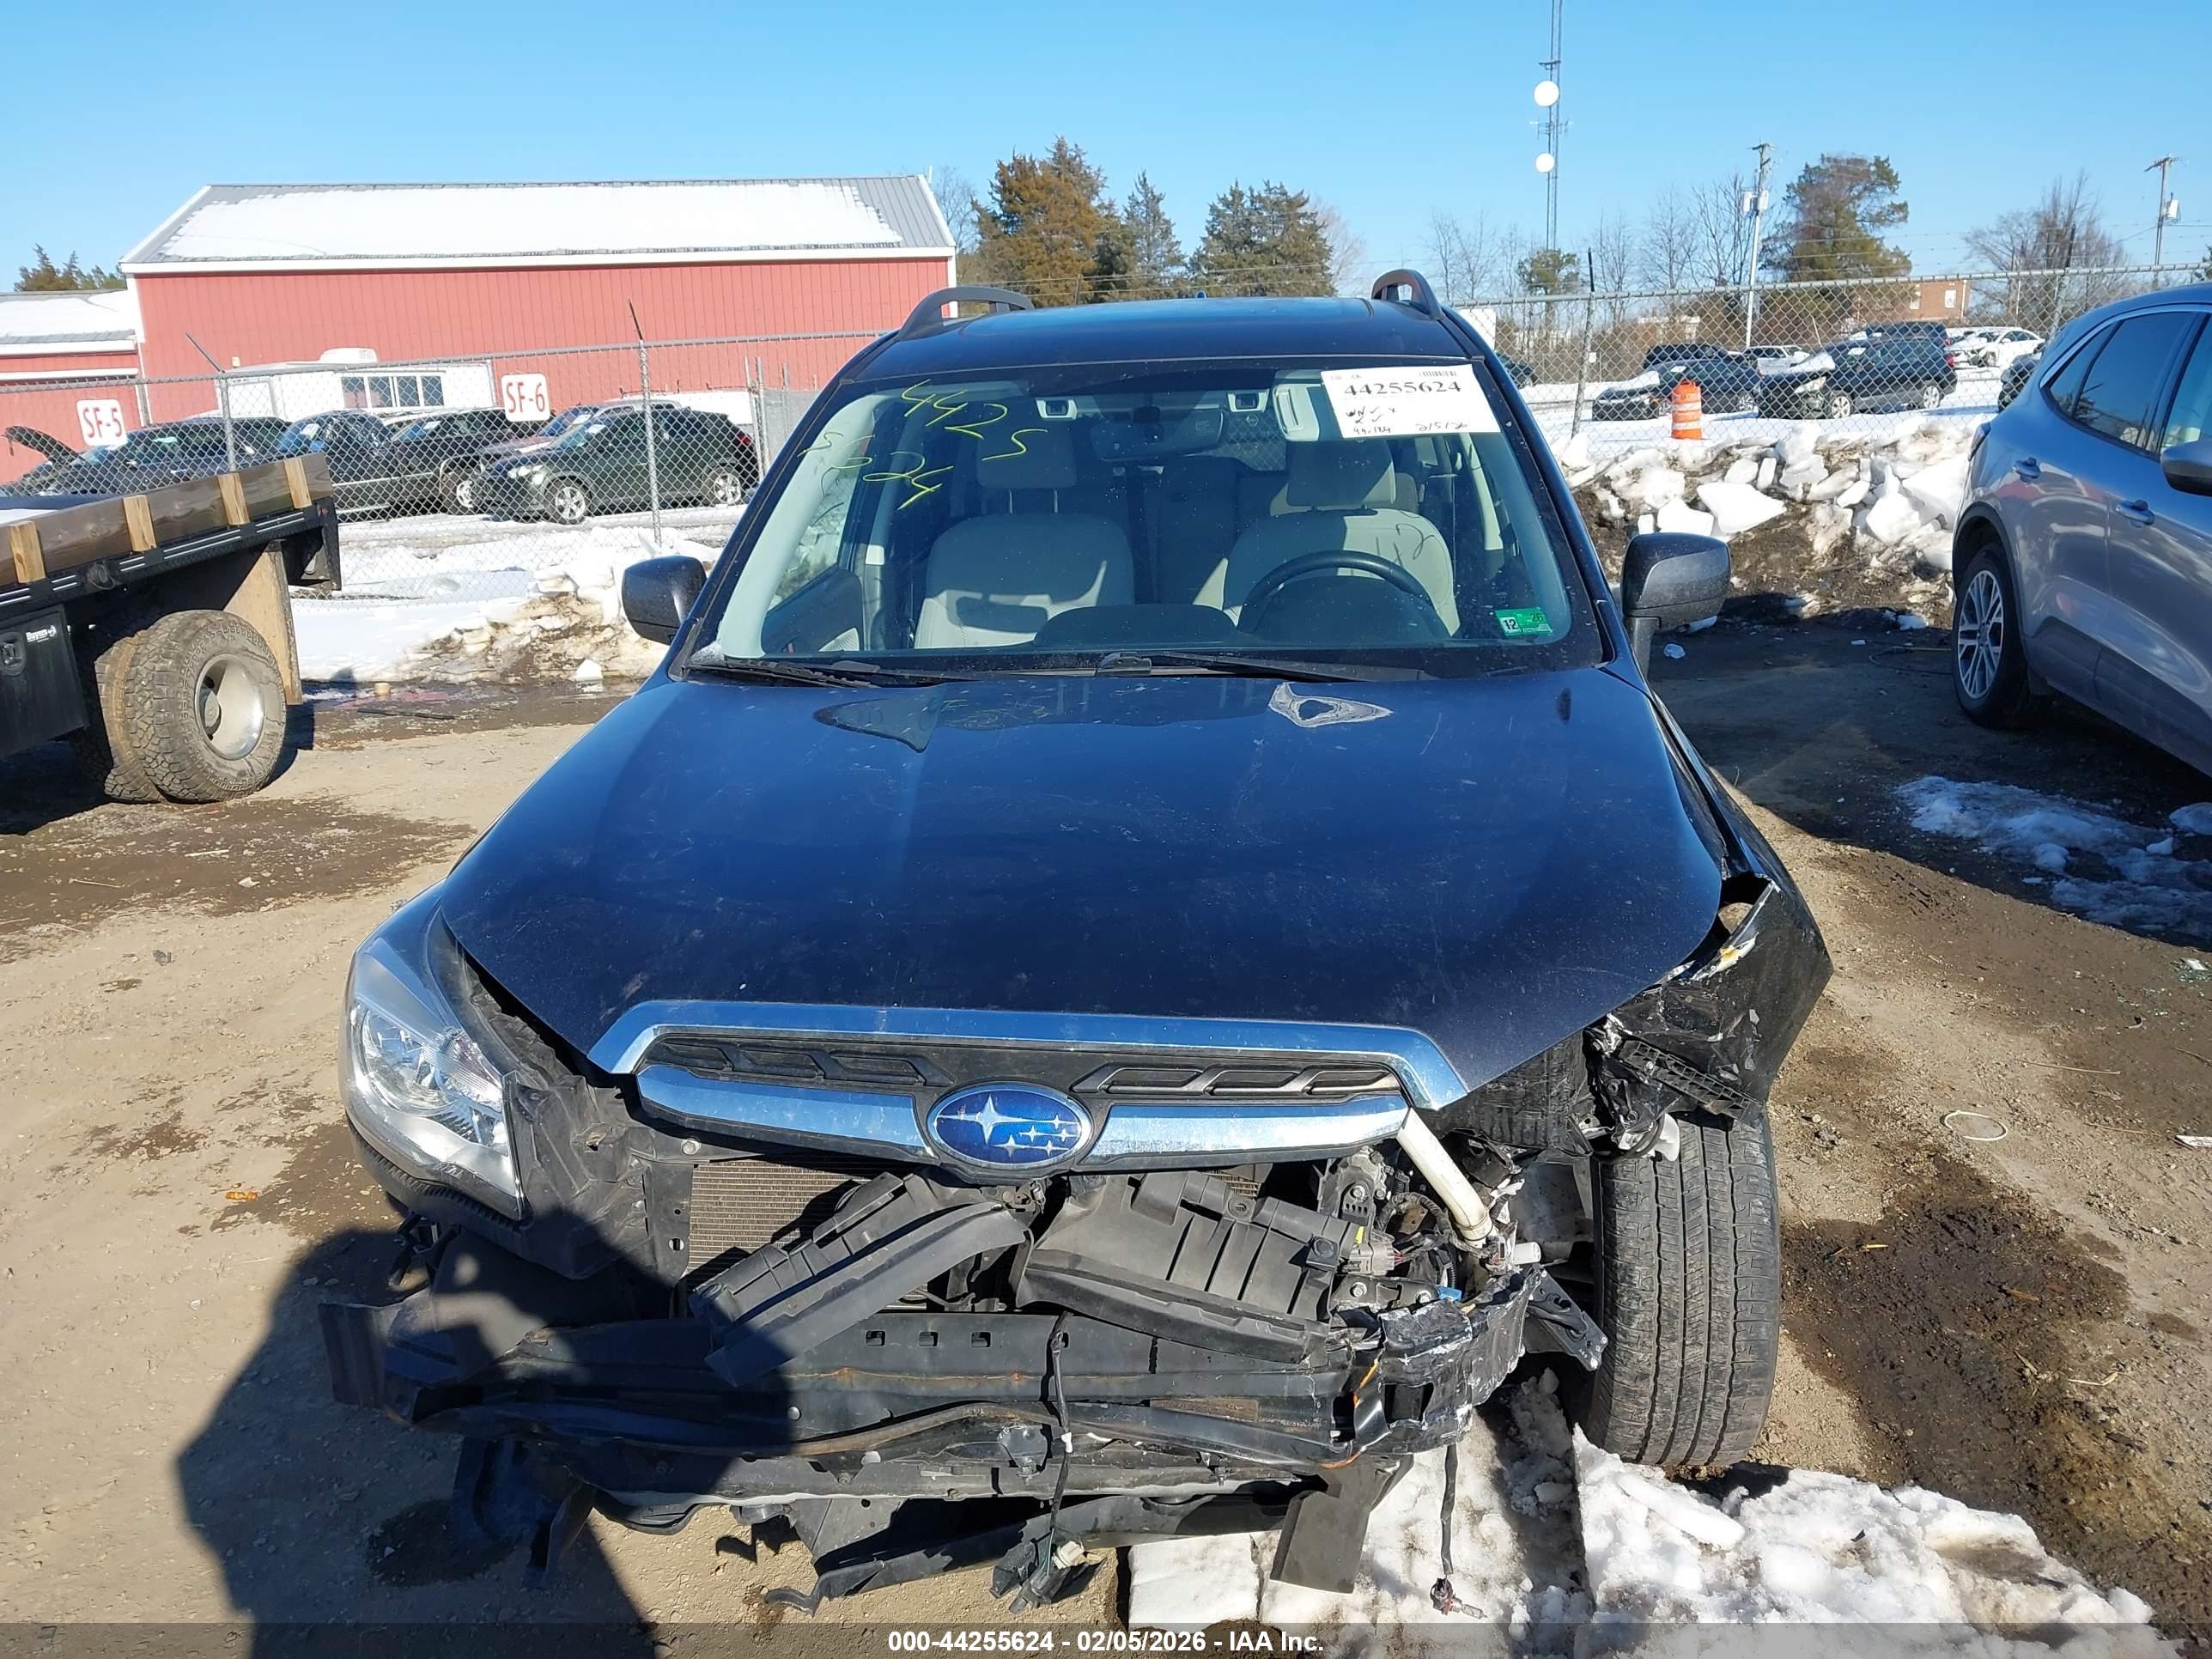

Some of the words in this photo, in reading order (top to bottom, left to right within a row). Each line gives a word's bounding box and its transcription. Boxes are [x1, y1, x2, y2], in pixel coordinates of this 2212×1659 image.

[506, 382, 545, 413] SF-6
[1343, 380, 1463, 396] 44255624
[82, 407, 123, 439] SF-5
[1503, 618, 1519, 630] 12
